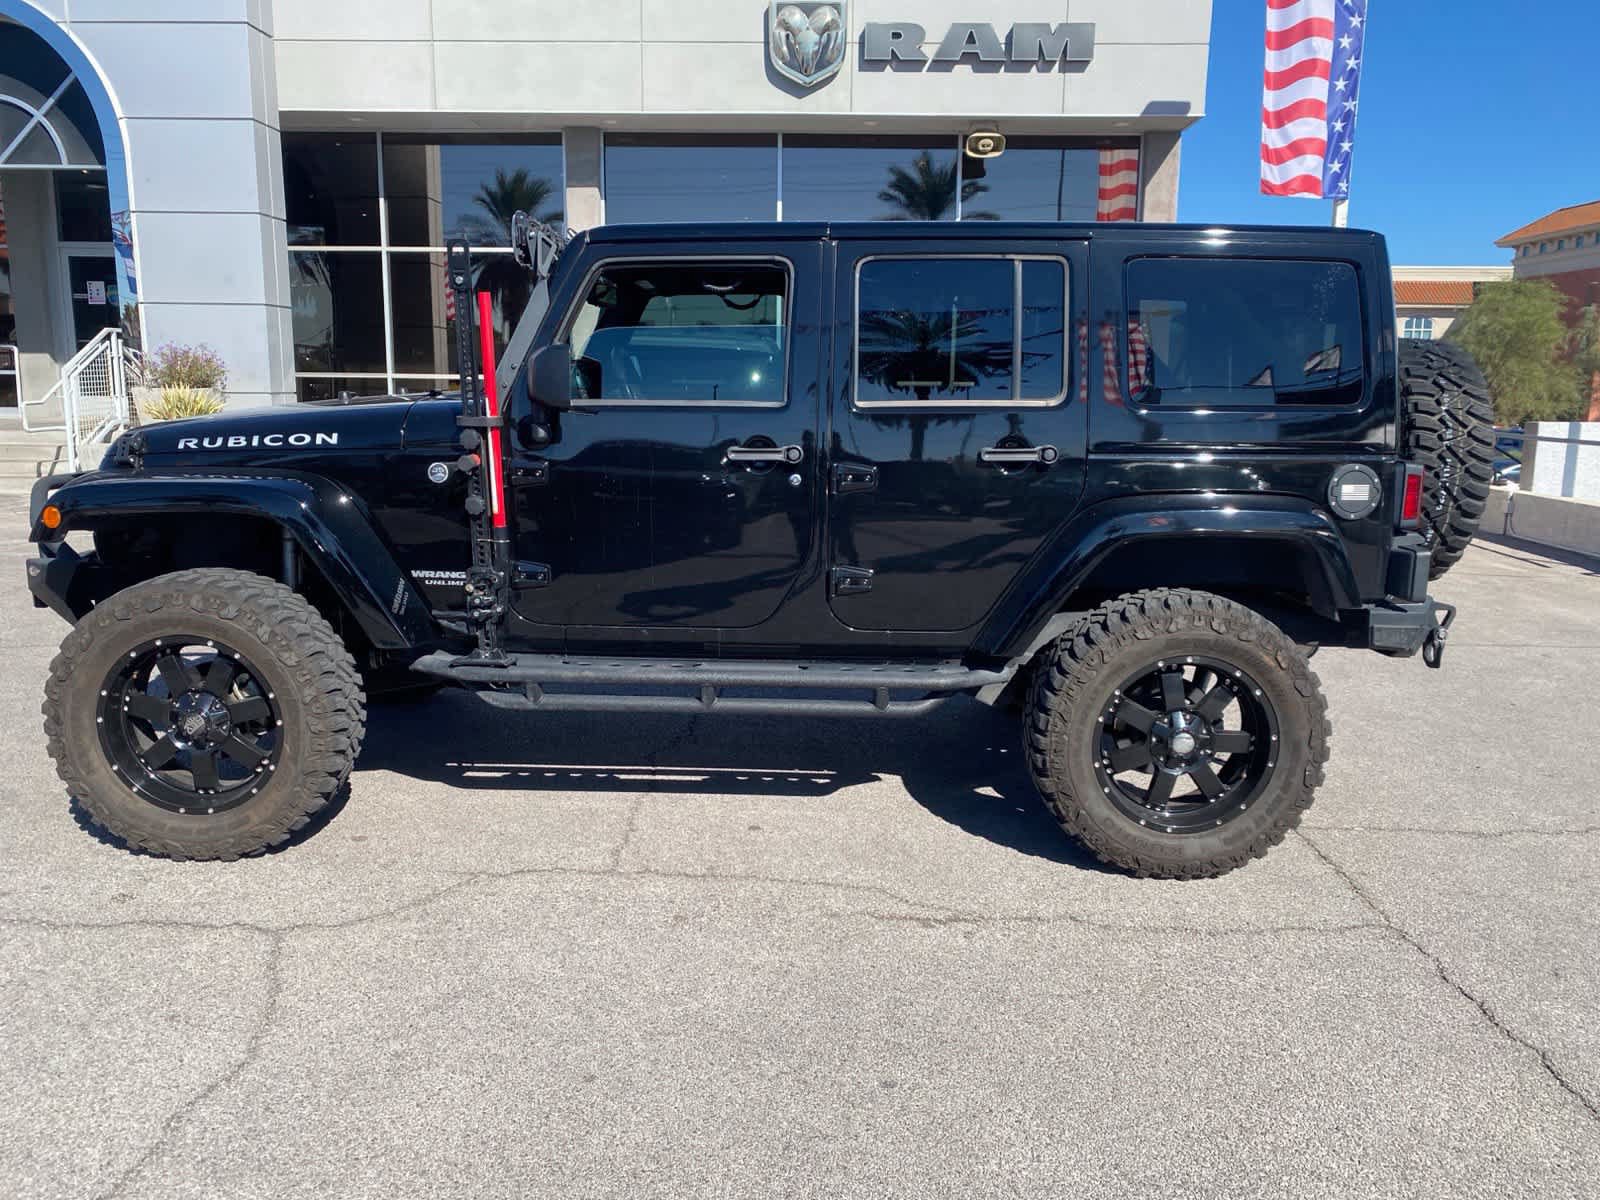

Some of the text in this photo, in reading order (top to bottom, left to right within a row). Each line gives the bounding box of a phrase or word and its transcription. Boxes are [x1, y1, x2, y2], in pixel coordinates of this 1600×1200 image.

[861, 22, 1096, 63] RAM
[177, 432, 339, 450] RUBICON
[411, 570, 467, 579] WRANG
